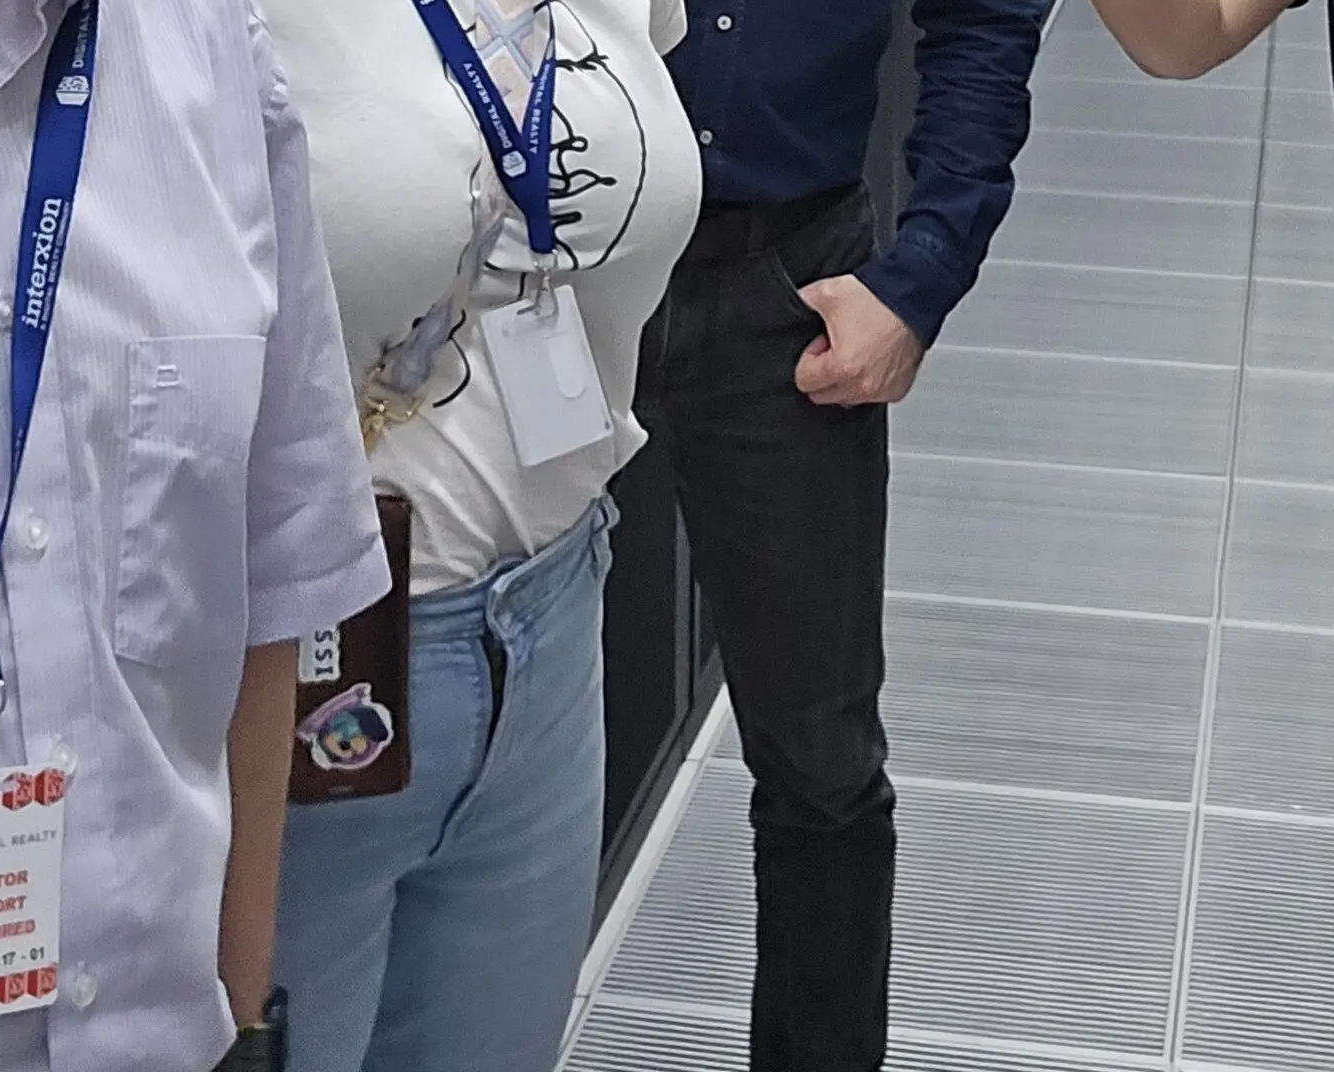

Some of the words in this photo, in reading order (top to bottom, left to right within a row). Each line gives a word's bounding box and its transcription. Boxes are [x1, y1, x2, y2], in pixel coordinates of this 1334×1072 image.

[463, 63, 491, 104] REALTY
[488, 104, 513, 149] DIGITAL
[529, 108, 542, 155] REALTY
[21, 198, 63, 328] interxion
[11, 829, 57, 847] REALTY
